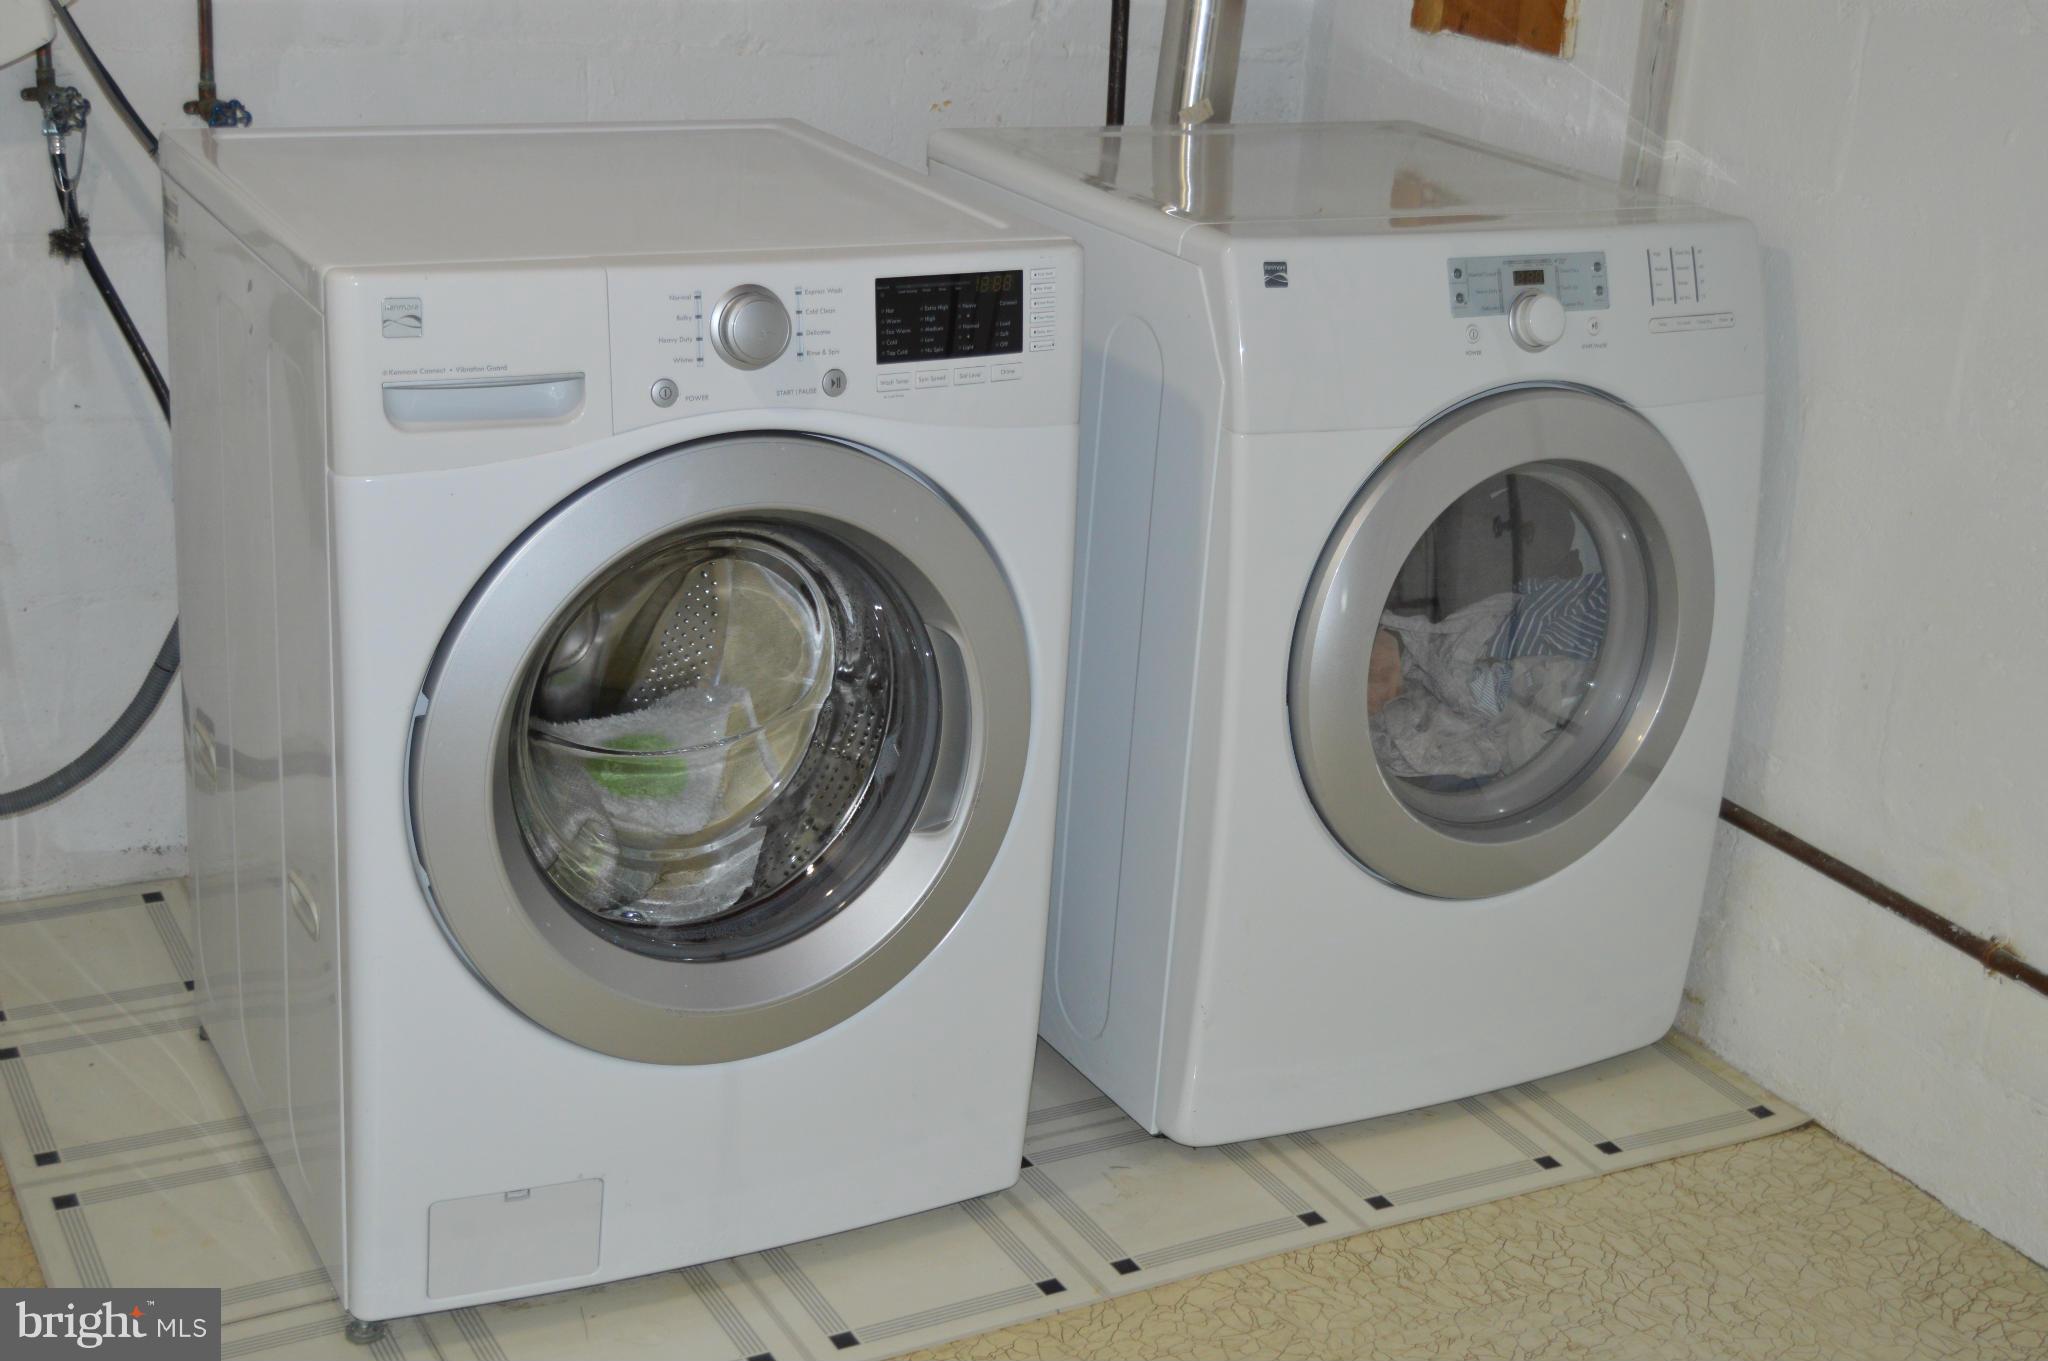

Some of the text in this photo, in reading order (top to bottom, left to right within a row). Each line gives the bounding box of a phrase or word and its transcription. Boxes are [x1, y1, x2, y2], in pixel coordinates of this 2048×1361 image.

[384, 303, 419, 311] Kenmore
[679, 335, 693, 343] Duty
[388, 368, 418, 376] Kenmore
[419, 367, 446, 375] Connect
[776, 387, 817, 397] START PAUSE
[684, 394, 709, 402] POWER
